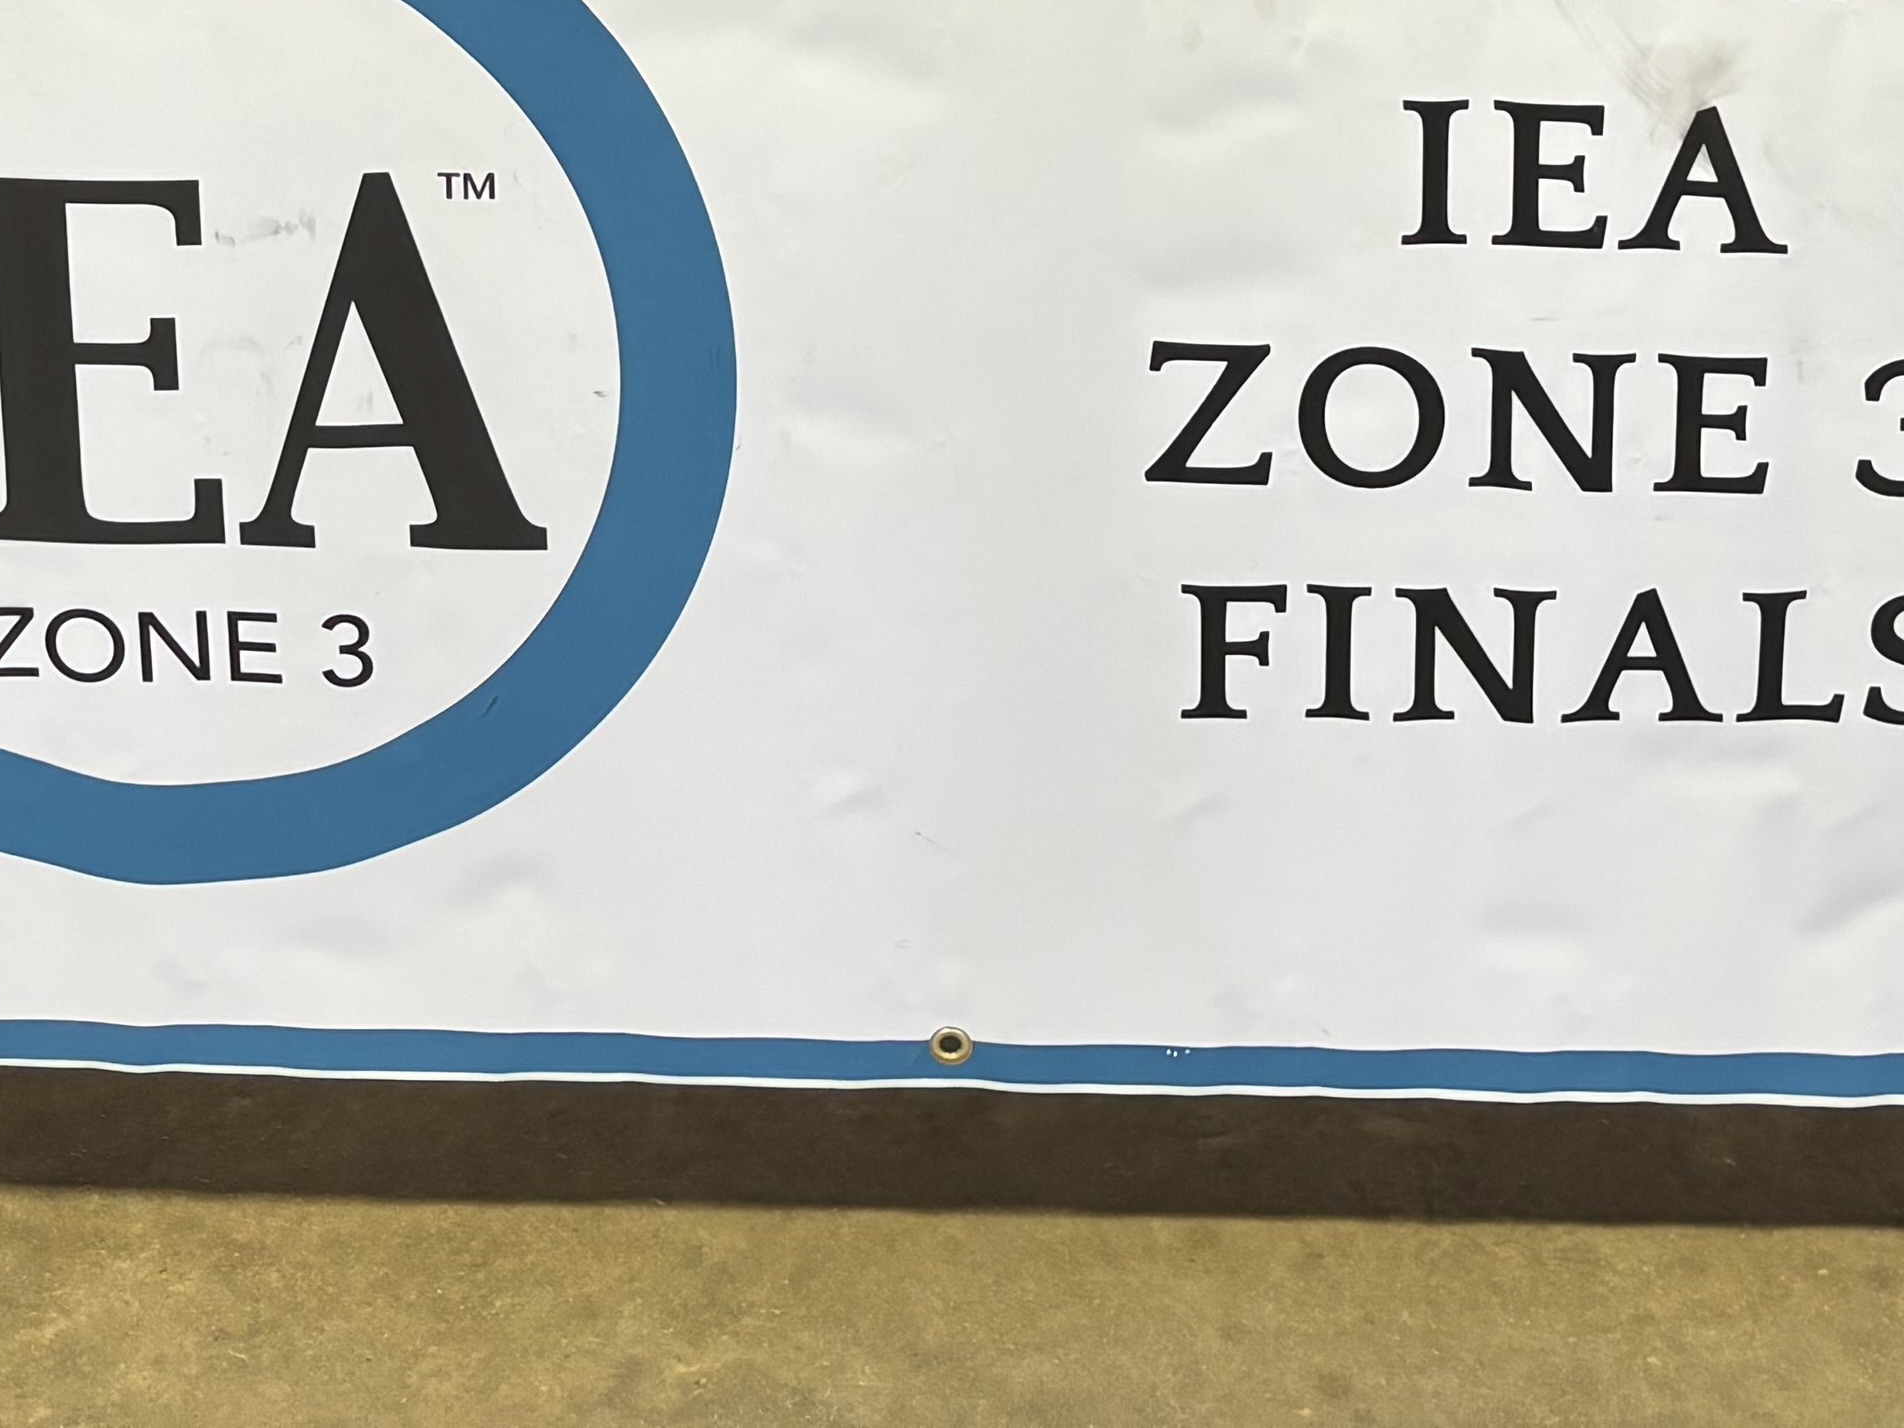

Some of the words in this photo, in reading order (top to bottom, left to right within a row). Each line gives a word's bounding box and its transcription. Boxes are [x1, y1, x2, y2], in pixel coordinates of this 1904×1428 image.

[1401, 99, 1788, 255] IEA
[1144, 340, 1769, 495] ZONE
[321, 614, 374, 688] 3
